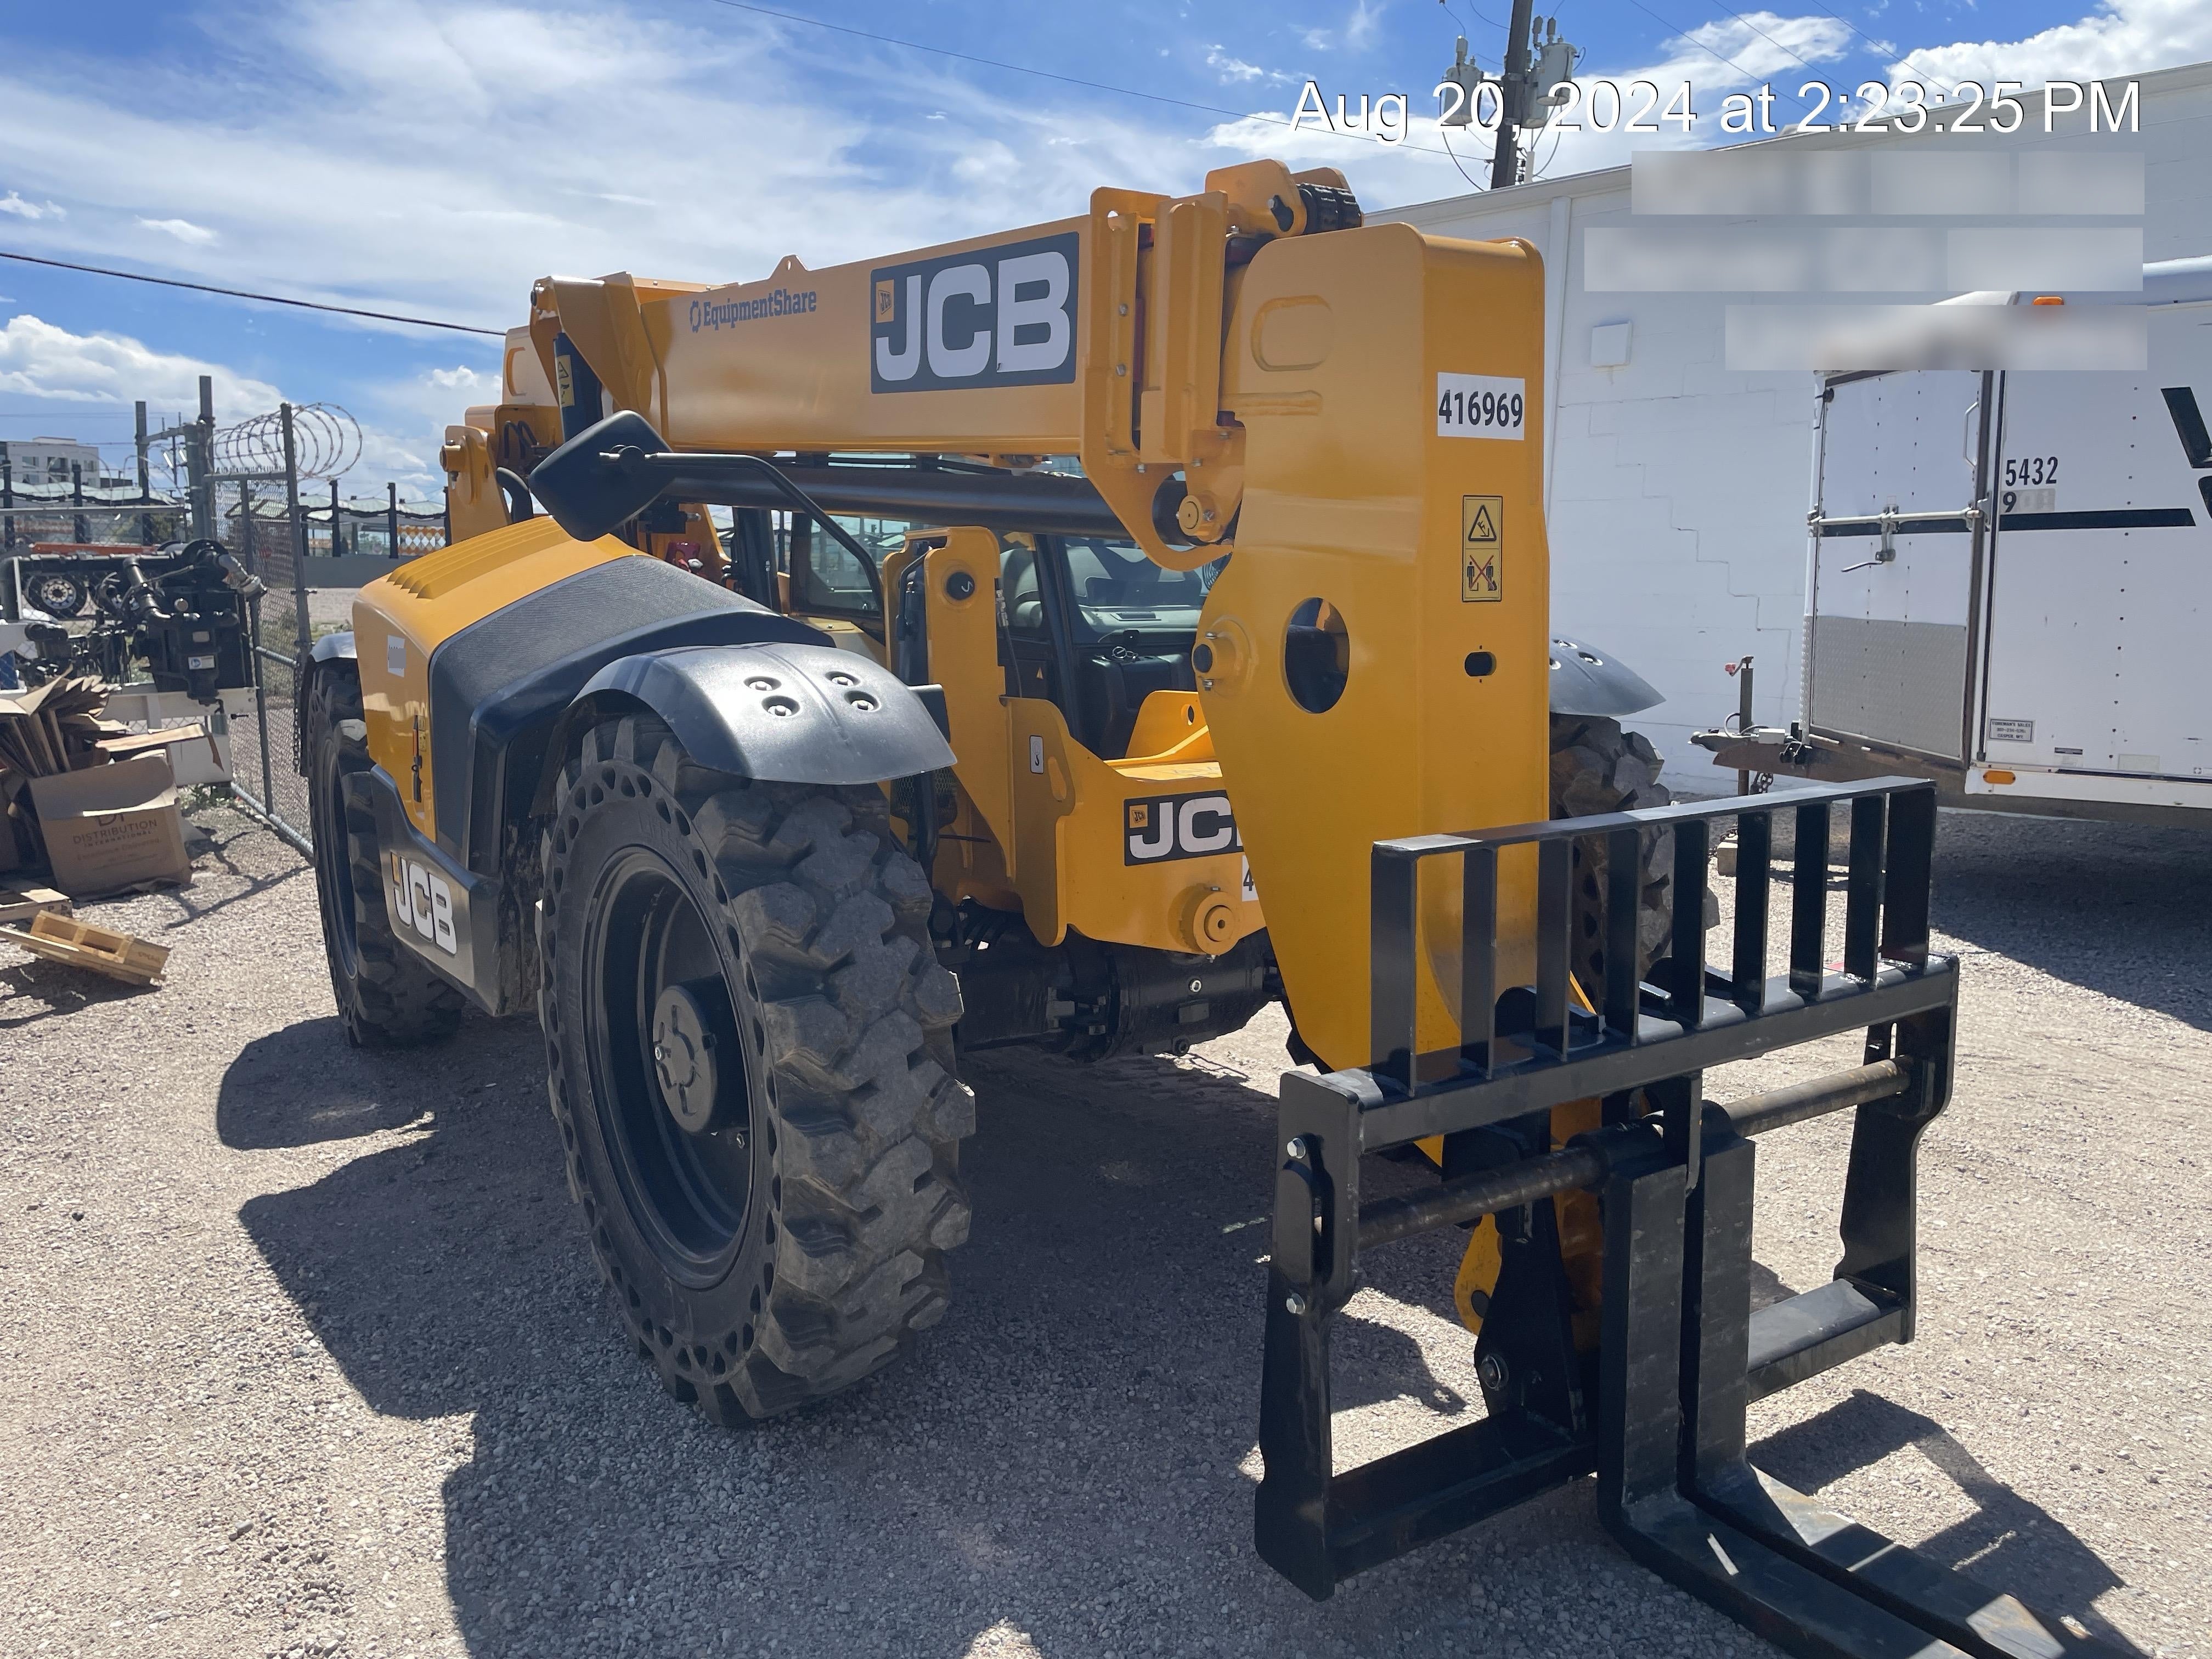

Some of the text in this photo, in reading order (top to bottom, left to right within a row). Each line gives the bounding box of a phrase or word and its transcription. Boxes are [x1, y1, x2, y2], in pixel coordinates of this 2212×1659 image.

[703, 289, 816, 330] EquipmentShare
[876, 251, 1070, 381] JCB
[1438, 390, 1523, 427] 416969
[2006, 456, 2058, 487] 5432
[73, 819, 157, 844] DISTRIBUTION
[1130, 797, 1243, 859] JC
[392, 857, 457, 956] JCB
